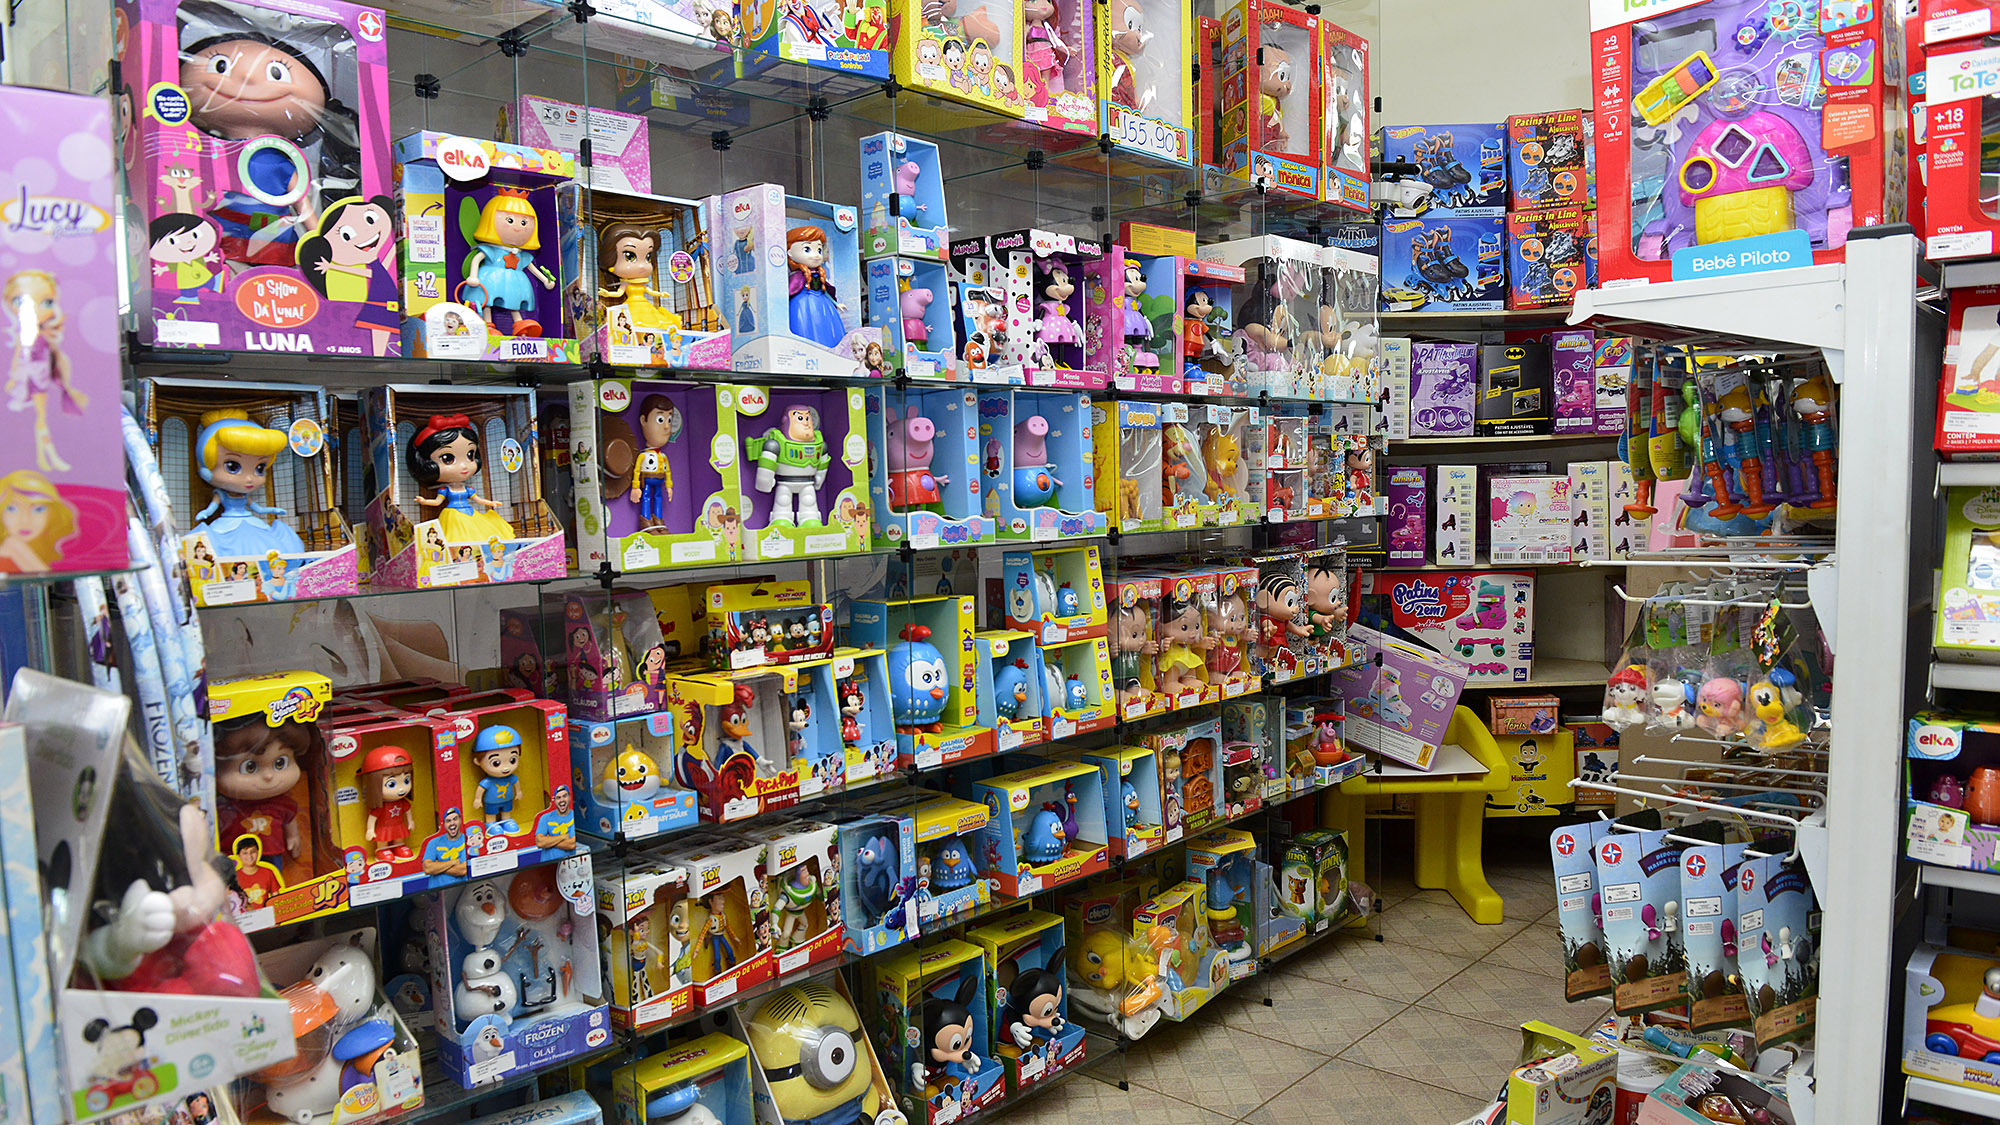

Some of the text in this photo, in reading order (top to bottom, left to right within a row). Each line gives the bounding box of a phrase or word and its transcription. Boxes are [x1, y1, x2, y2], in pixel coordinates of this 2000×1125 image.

[1932, 8, 1958, 19] CONTÉM
[1603, 44, 1619, 52] meses
[1604, 35, 1618, 46] +9
[840, 62, 863, 70] Soninho
[1916, 76, 1926, 90] 3
[1514, 113, 1577, 128] Patins In Line
[1934, 108, 1964, 123] +18
[1548, 125, 1579, 134] Ajustáveis
[1937, 121, 1961, 131] meses
[1614, 130, 1623, 138] luz
[1281, 161, 1298, 171] TURMA
[1278, 169, 1311, 188] Mônica
[11, 185, 86, 234] Lucy
[1514, 210, 1577, 225] Patins In Line
[1548, 220, 1579, 230] Ajustáveis
[1337, 229, 1368, 240] MINI
[1937, 225, 1963, 234] CONTÉM
[953, 240, 980, 256] MINNIE
[995, 234, 1025, 250] MINNIE
[1327, 237, 1378, 249] TRAVESSOS
[1693, 249, 1791, 273] Bebê Piloto
[414, 271, 437, 290] +12
[245, 331, 313, 353] LUNA
[511, 343, 538, 356] FLORA
[1557, 340, 1588, 348] ROLLER
[338, 346, 362, 354] ANOS
[1604, 347, 1622, 357] FUN
[735, 358, 762, 371] FROZEN
[1416, 367, 1450, 375] AJUSTÁVEIS
[1392, 475, 1421, 484] ROLLER
[1393, 579, 1439, 613] Patins
[299, 700, 319, 717] JP
[145, 701, 175, 785] FROZEN
[755, 771, 798, 794] PICA-PAU
[1186, 809, 1209, 824] CONJUNTO
[1190, 818, 1206, 830] MASHA
[251, 819, 268, 832] JP
[779, 845, 797, 861] TOY
[780, 855, 797, 867] STORY
[1647, 858, 1668, 873] MASHA
[702, 866, 721, 882] TOY
[316, 878, 341, 902] JP
[703, 877, 721, 890] STORY
[626, 887, 646, 904] TOY
[274, 899, 314, 918] rticulado
[627, 898, 646, 912] STORY
[812, 931, 838, 951] DE VINIL
[741, 955, 768, 975] DE VINIL
[169, 1005, 221, 1030] Mickey
[165, 1018, 231, 1046] Divertido
[525, 1023, 565, 1045] FROZEN
[533, 1046, 556, 1060] OLAF
[1563, 1057, 1616, 1085] Meu Primeiro Carrinho
[344, 1085, 374, 1106] Go Baby
